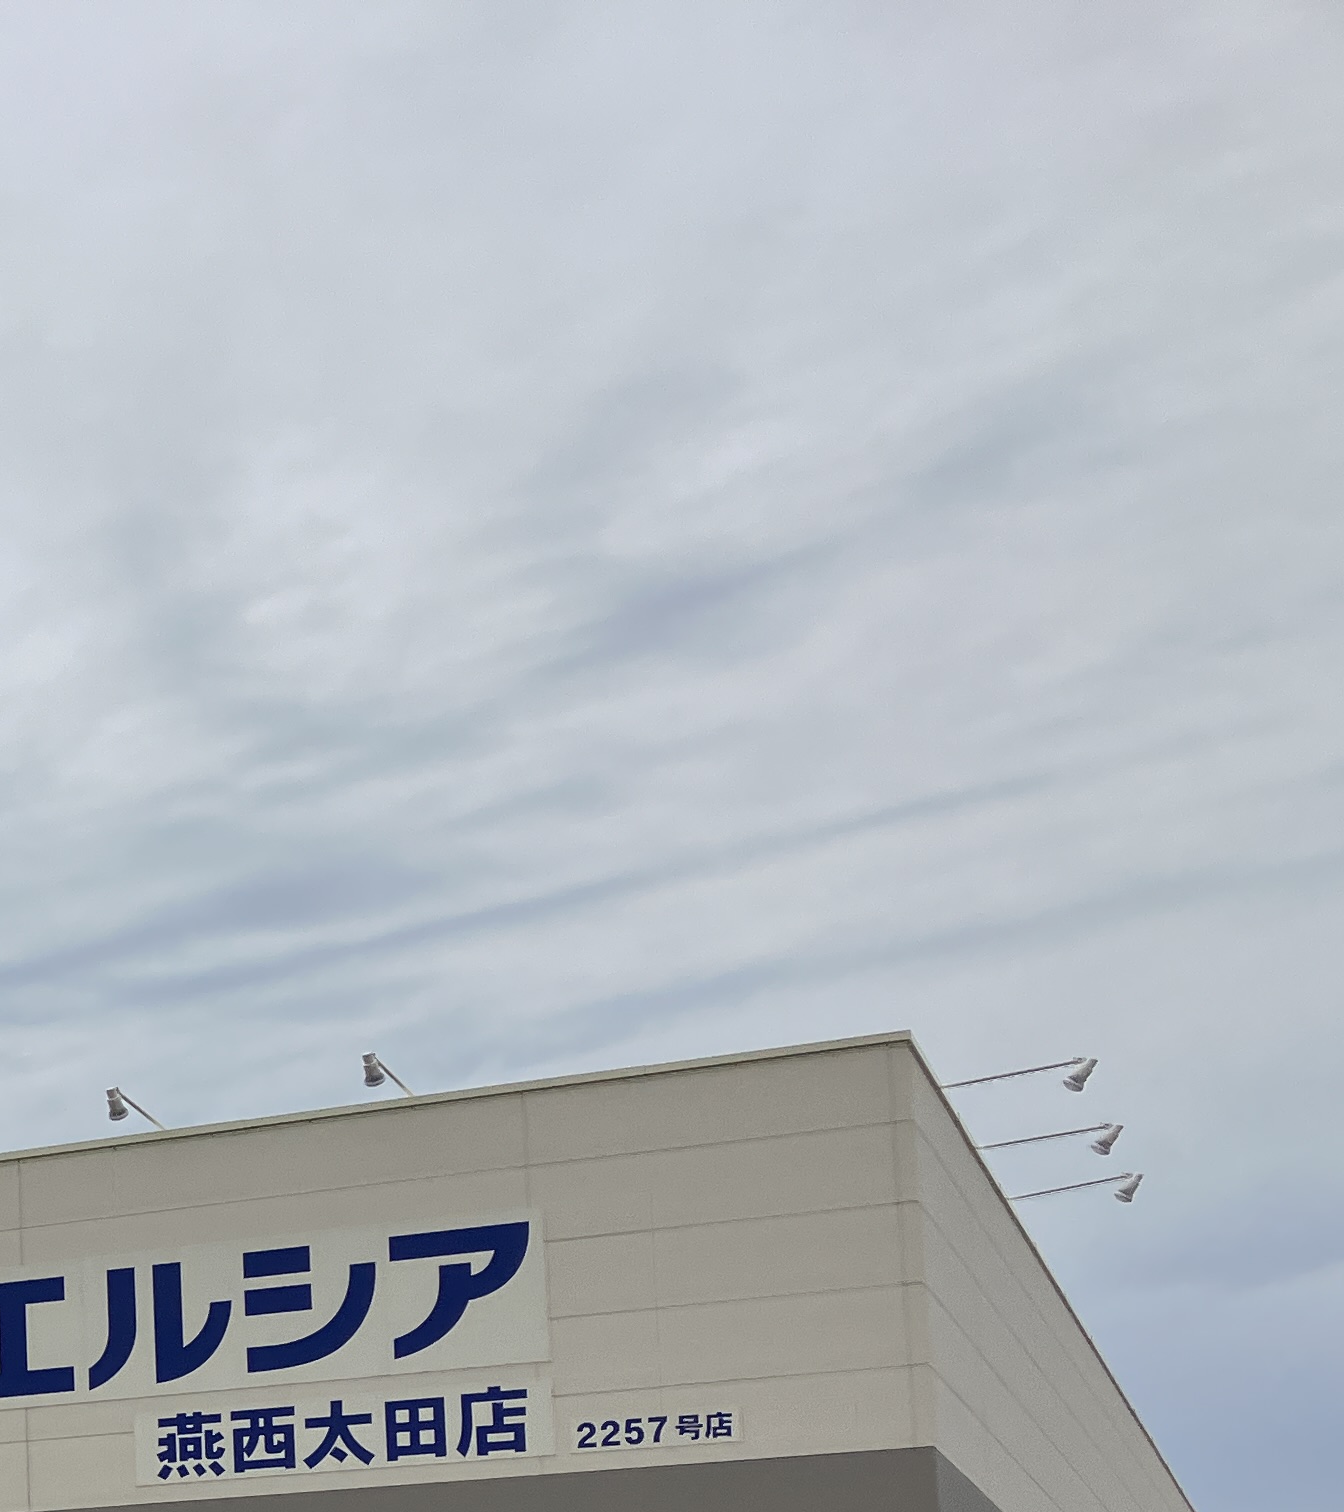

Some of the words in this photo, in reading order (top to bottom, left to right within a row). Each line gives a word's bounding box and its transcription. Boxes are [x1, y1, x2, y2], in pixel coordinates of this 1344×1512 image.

[157, 1387, 529, 1481] 燕西太田店
